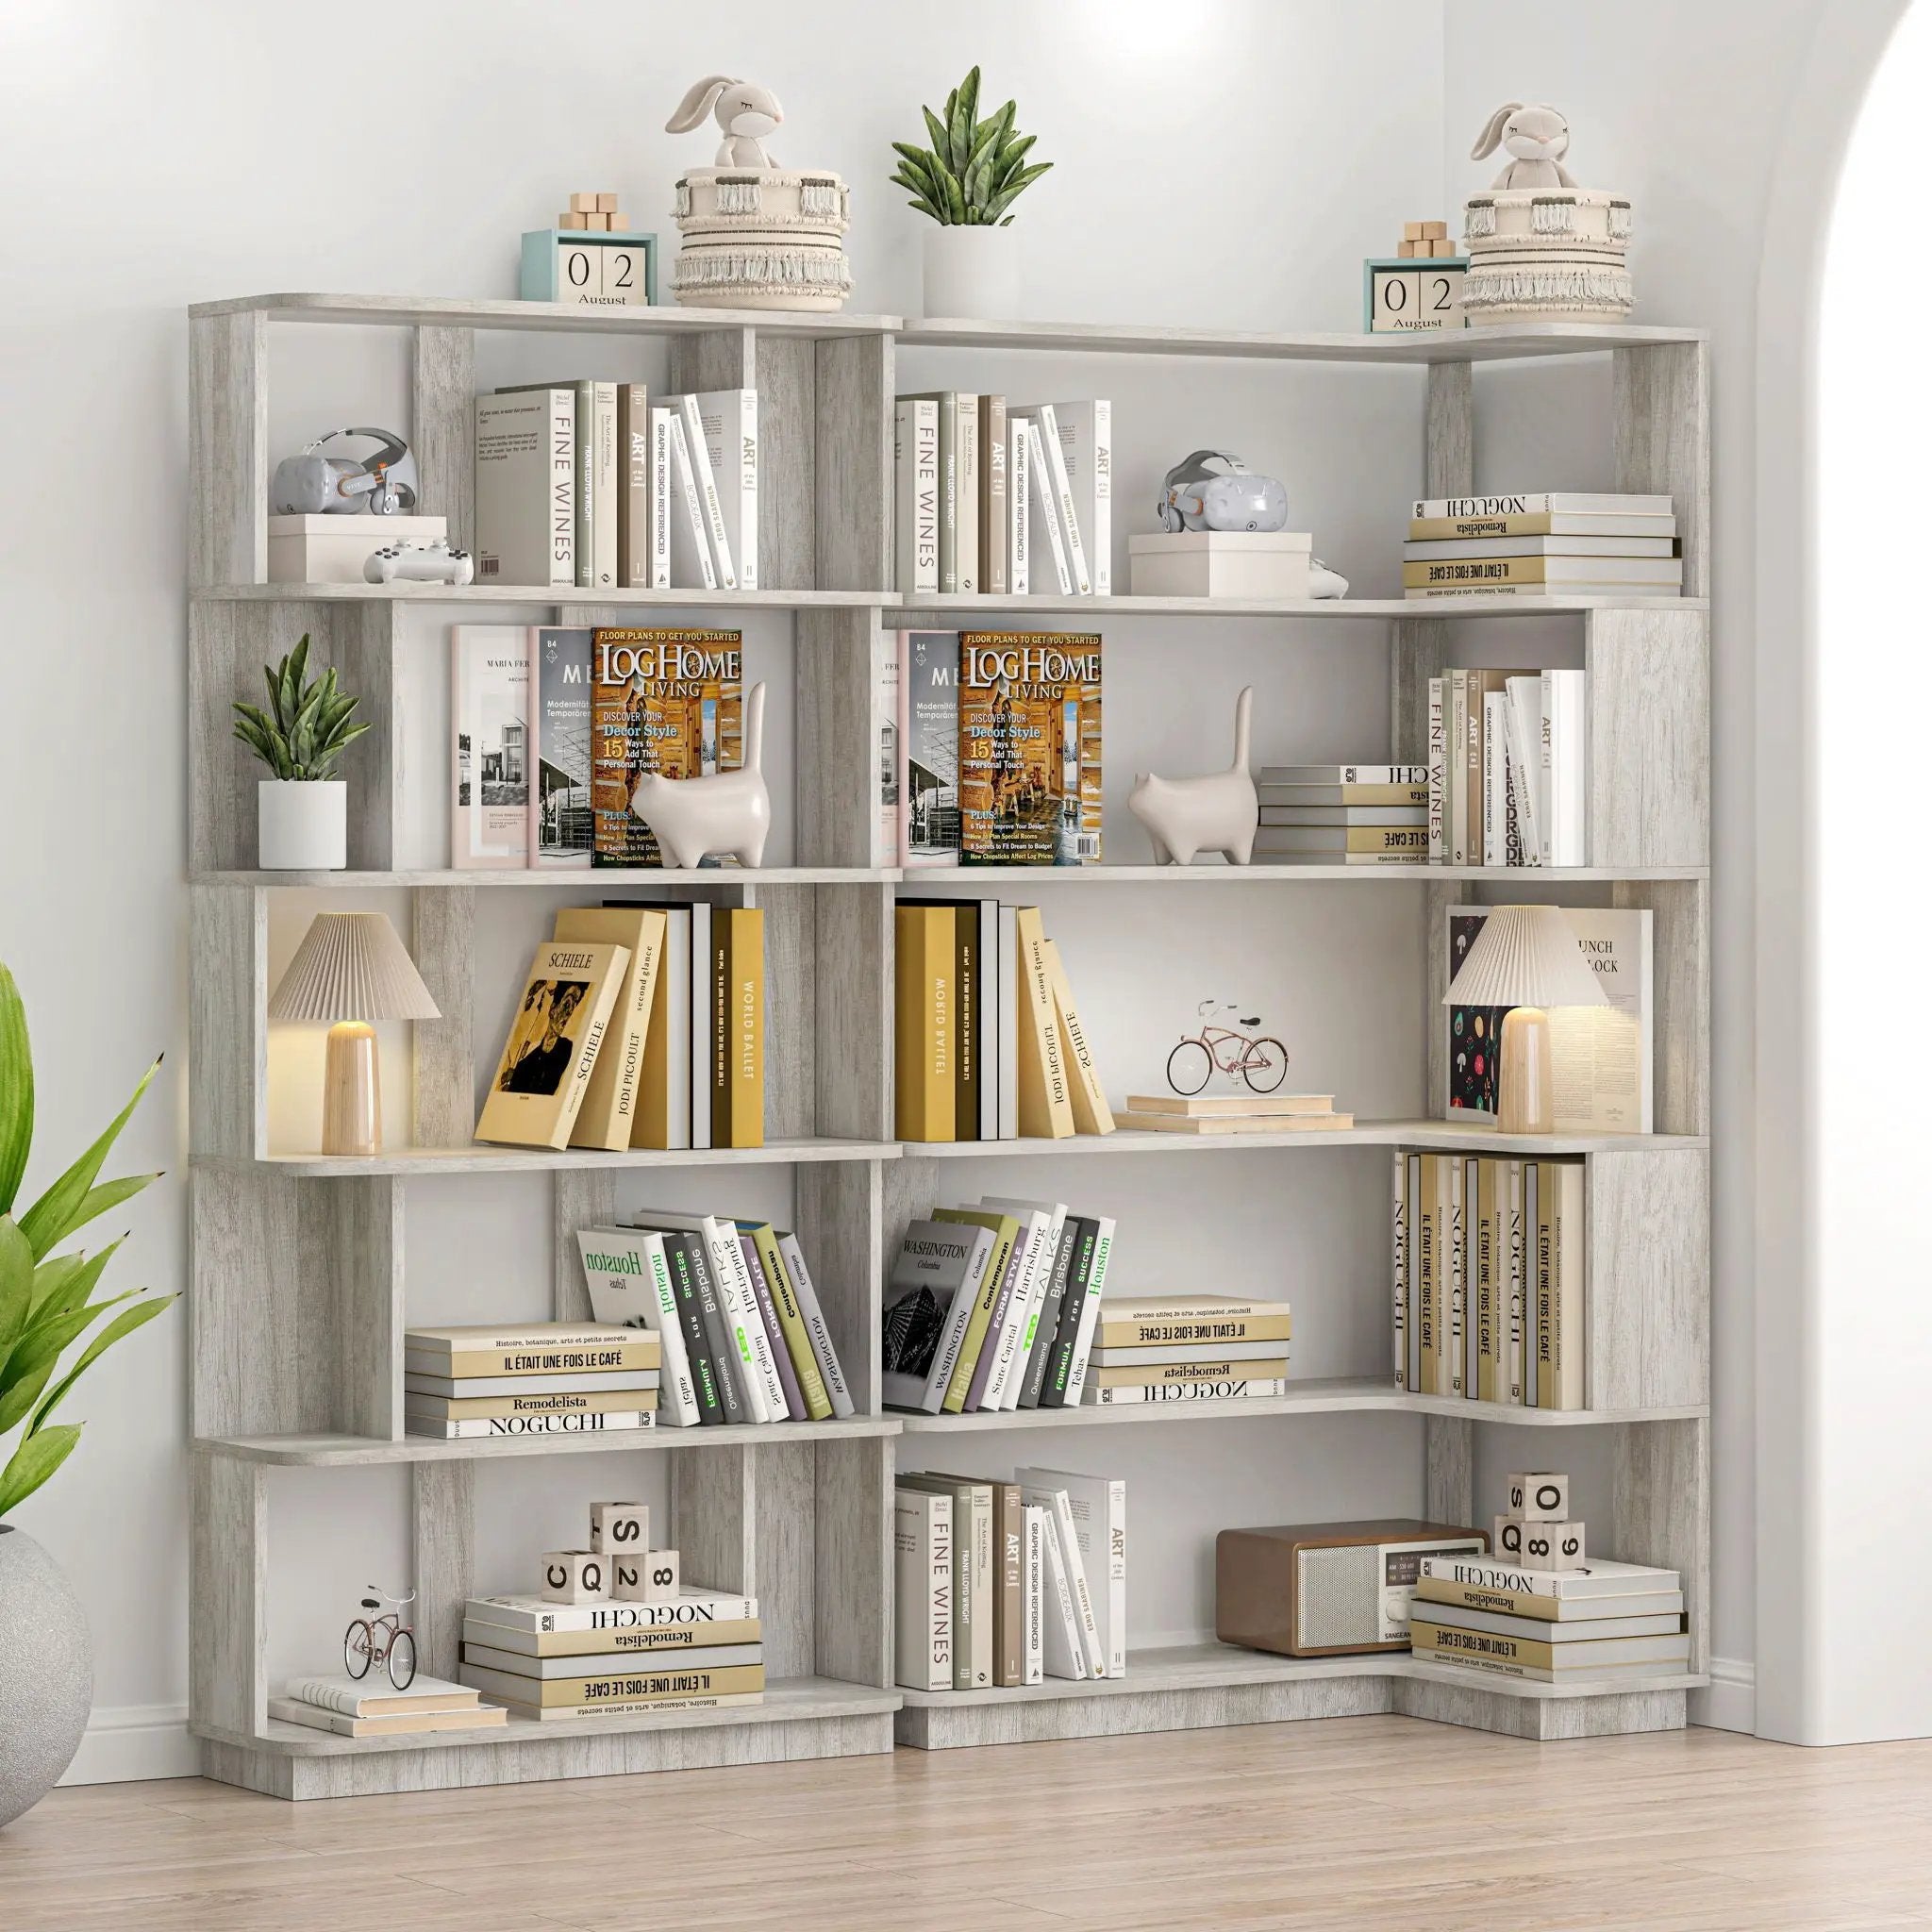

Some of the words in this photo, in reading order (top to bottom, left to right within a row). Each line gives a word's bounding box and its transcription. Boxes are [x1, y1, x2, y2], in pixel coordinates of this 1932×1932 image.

[578, 293, 627, 306] August
[1393, 318, 1442, 330] August
[555, 417, 571, 470] FINE
[631, 432, 645, 465] ART
[658, 424, 666, 462] GRAPHIC
[742, 437, 756, 469] ART
[919, 427, 934, 478] FINE
[992, 441, 1005, 474] ART
[1097, 446, 1108, 477] ART
[658, 464, 666, 496] DESIGN
[1447, 496, 1526, 517] NOGUCHI
[555, 482, 571, 561] WINES
[658, 498, 666, 555] REFERENCED
[919, 491, 934, 568] WINES
[1457, 522, 1507, 535] Remodelista
[600, 631, 625, 640] FLOOR
[628, 631, 654, 641] PLANS
[656, 632, 666, 641] TO
[668, 632, 684, 641] GET
[704, 633, 739, 641] STARTED
[967, 635, 991, 643] FLOOR
[993, 635, 1018, 643] PLANS
[1032, 636, 1047, 644] GET
[1049, 636, 1064, 644] YOU
[1066, 636, 1099, 644] STARTED
[487, 659, 512, 668] MARIA
[641, 682, 700, 697] LIVING
[1006, 684, 1062, 699] LIVING
[970, 713, 1006, 724] DISCOVER
[1007, 712, 1026, 724] YOUR
[970, 725, 1007, 738] Decor
[1008, 725, 1041, 740] Style
[1431, 704, 1441, 754] FINE
[1469, 717, 1478, 746] ART
[1541, 717, 1551, 747] ART
[970, 741, 990, 758] 15
[991, 741, 1009, 750] Ways
[991, 750, 1005, 758] Add
[1008, 750, 1023, 758] That
[971, 760, 1002, 769] Personal
[1004, 760, 1024, 769] Touch
[1431, 764, 1441, 840] WINES
[548, 952, 593, 969] SCHIELE
[637, 979, 647, 1011] second
[642, 945, 653, 977] glance
[743, 980, 755, 1028] WORLD
[577, 1021, 605, 1081] SCHIELE
[624, 1032, 640, 1086] PICOULT
[743, 1034, 755, 1079] BALLET
[618, 1089, 631, 1116] JODI
[1423, 1214, 1431, 1224] IL
[903, 1240, 968, 1259] WASHINGTON
[1423, 1227, 1431, 1256] ÉTAIT
[972, 1247, 988, 1279] Columbia
[983, 1241, 1009, 1310] Contemporan
[1015, 1226, 1045, 1302] Harrisburg
[1050, 1234, 1074, 1299] Brisbane
[1088, 1237, 1110, 1296] Houston
[1423, 1258, 1431, 1279] UNE
[1453, 1206, 1461, 1336] NOGUCHI
[993, 1291, 1009, 1329] FORM
[1006, 1245, 1023, 1288] STYLE
[1023, 1313, 1039, 1352] TED
[1033, 1227, 1061, 1304] TALKS
[1423, 1281, 1431, 1305] FOIS
[1056, 1341, 1072, 1391] FORMULA
[1070, 1299, 1080, 1322] FOR
[1077, 1235, 1094, 1283] SUCCESS
[1423, 1307, 1431, 1319] LE
[495, 1340, 524, 1348] Histoire,
[583, 1336, 603, 1344] petits
[1423, 1321, 1432, 1349] CAFÉ
[505, 1357, 513, 1371] IL
[515, 1353, 541, 1370] ÉTAIT
[542, 1355, 561, 1369] UNE
[563, 1353, 584, 1368] FOIS
[586, 1353, 597, 1366] LE
[599, 1349, 623, 1366] CAFÉ
[935, 1309, 968, 1391] WASHINGTON
[991, 1367, 1007, 1395] State
[1002, 1324, 1019, 1363] Capital
[951, 1361, 975, 1401] Italia
[1030, 1341, 1048, 1395] Queensland
[1071, 1357, 1085, 1389] Tehas
[513, 1395, 587, 1410] Remodelista
[489, 1412, 605, 1436] NOGUCHI
[934, 1524, 948, 1575] FINE
[1007, 1533, 1020, 1564] ART
[1111, 1527, 1124, 1558] ART
[1502, 1524, 1522, 1554] Q
[1527, 1539, 1550, 1557] 8
[961, 1550, 970, 1573] FRANK
[581, 1562, 602, 1592] Q
[653, 1567, 673, 1586] 8
[961, 1574, 970, 1596] LLOYD
[1455, 1564, 1534, 1594] NOGUCHI
[961, 1596, 970, 1624] WRIGHT
[1058, 1577, 1073, 1623] BORDEAUX
[1464, 1591, 1514, 1611] Remodelista
[591, 1603, 715, 1629] NOGUCHI
[934, 1586, 949, 1663] WINES
[615, 1631, 693, 1648] Remodelista
[585, 1682, 610, 1701] CAFÉ
[612, 1681, 624, 1695] LE
[625, 1679, 648, 1694] FOIS
[650, 1677, 670, 1692] UNE
[672, 1675, 699, 1692] ÉTAIT
[701, 1674, 710, 1689] IL
